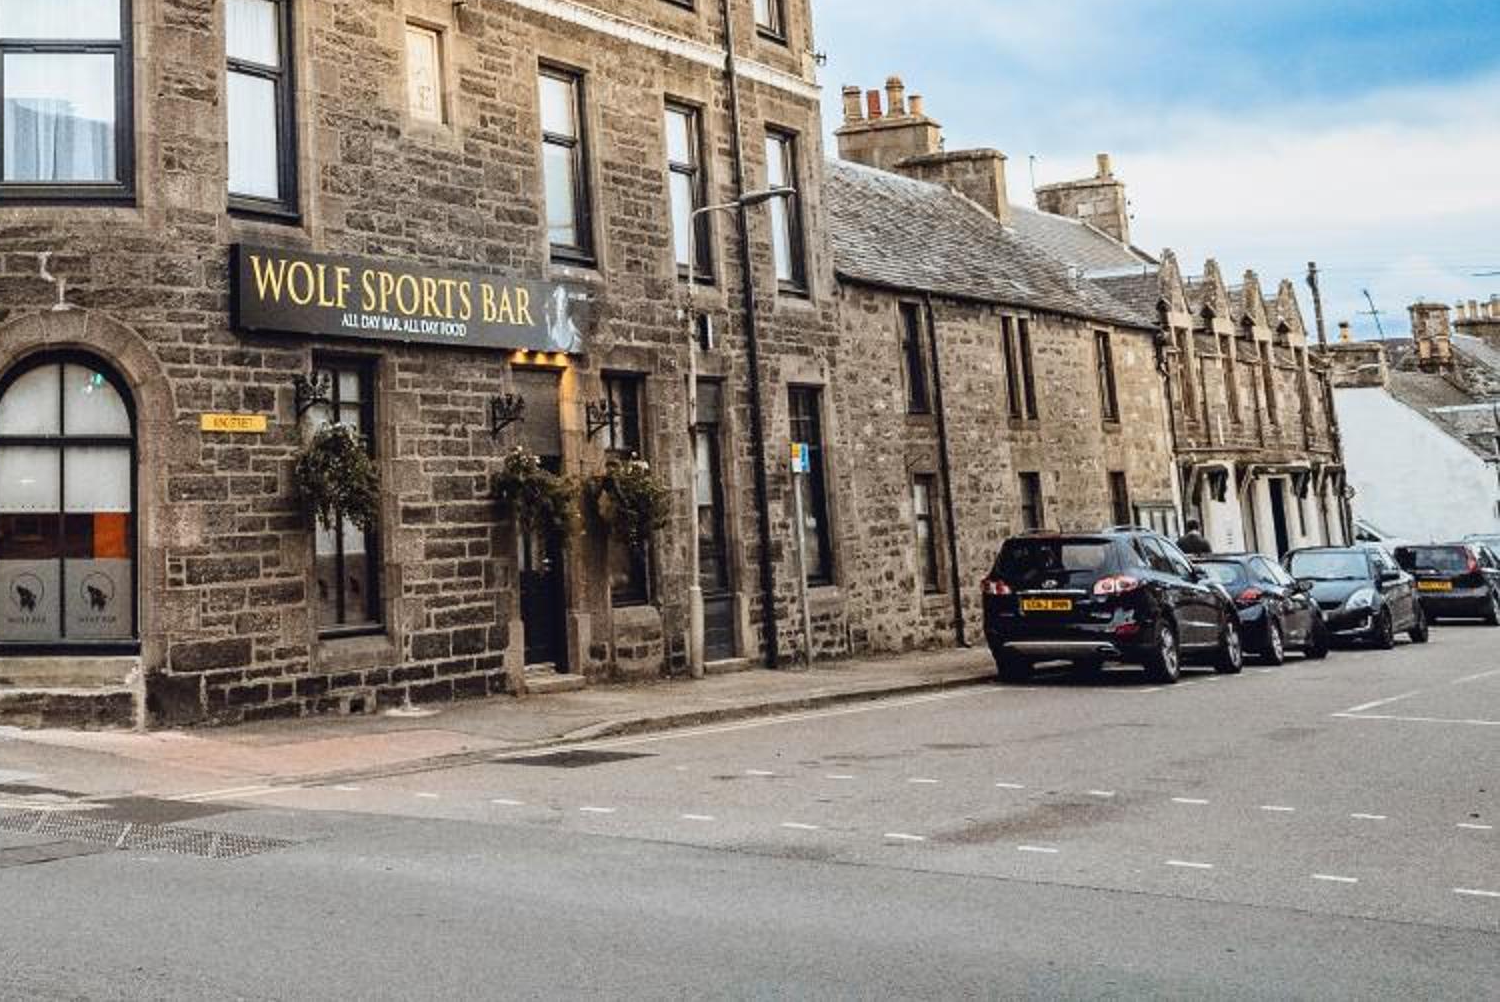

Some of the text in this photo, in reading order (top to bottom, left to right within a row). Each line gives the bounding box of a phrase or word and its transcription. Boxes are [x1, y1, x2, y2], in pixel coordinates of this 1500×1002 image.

[250, 255, 534, 327] WOLF SPORTS BAR
[341, 313, 358, 328] ALL
[361, 315, 380, 329] DAY
[403, 319, 420, 333] ALL
[421, 320, 439, 334] DAY
[439, 321, 467, 337] FOOD
